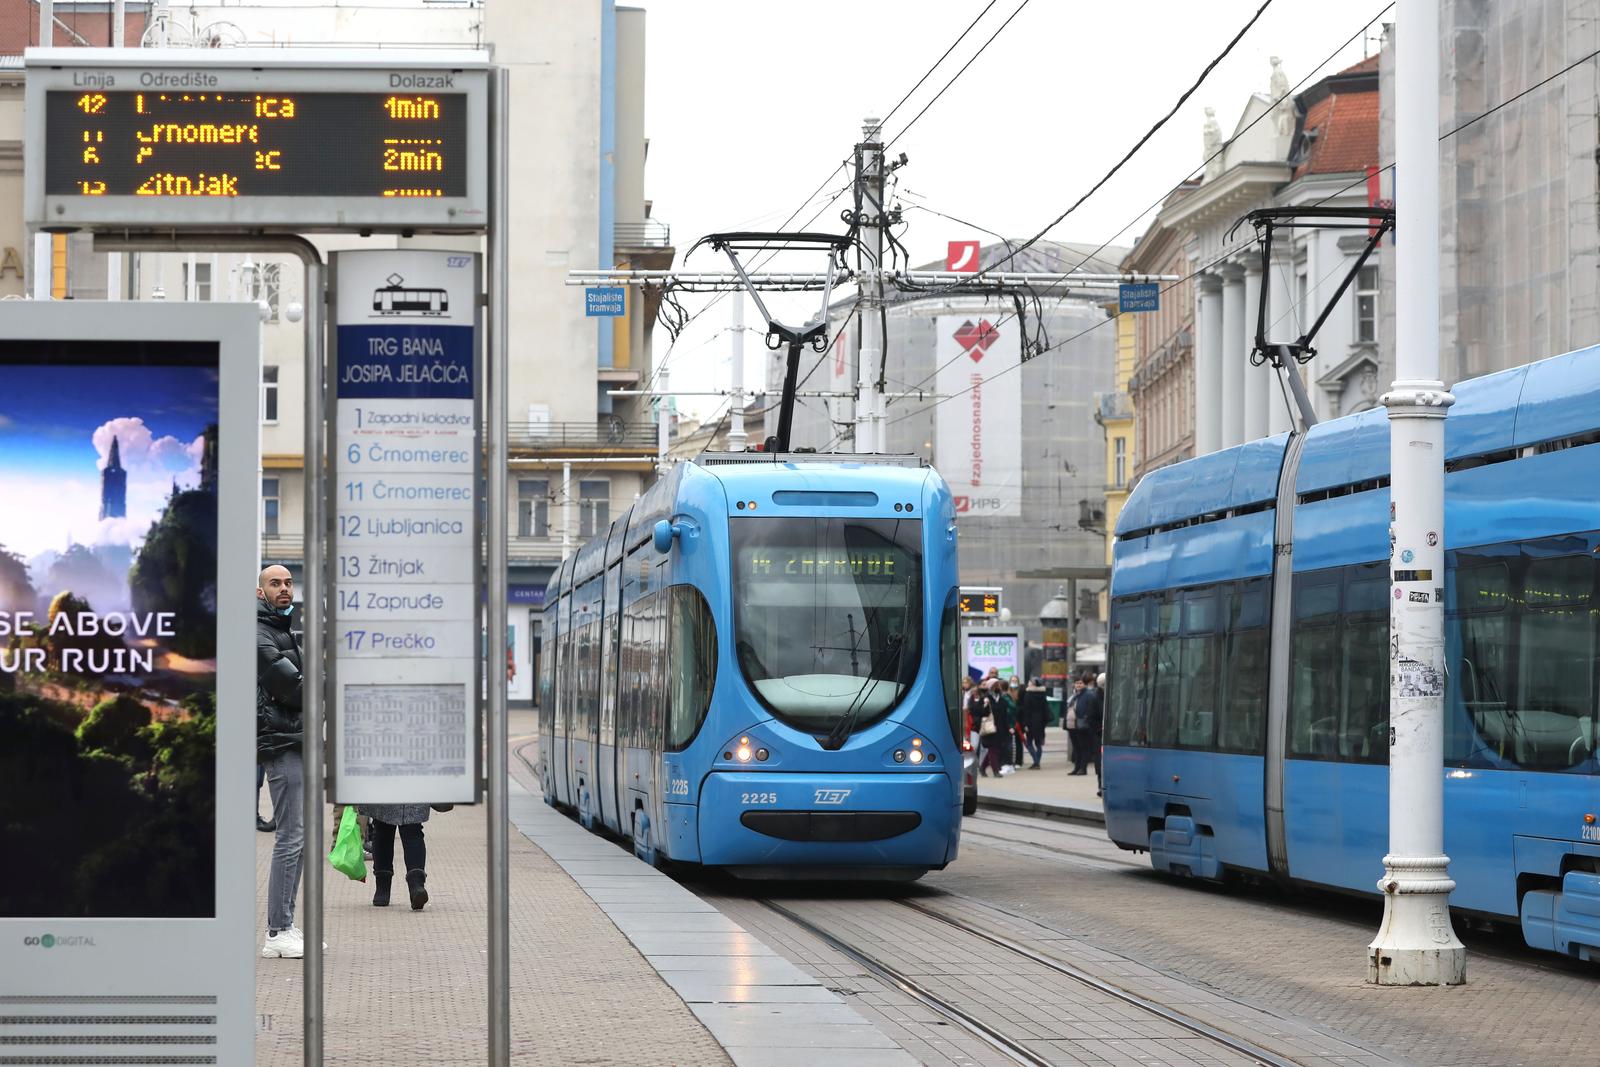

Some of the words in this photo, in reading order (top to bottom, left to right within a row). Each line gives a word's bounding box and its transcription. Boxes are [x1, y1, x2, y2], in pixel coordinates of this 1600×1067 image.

[73, 72, 115, 87] Linija
[140, 71, 218, 87] Odredište
[390, 73, 454, 88] Dolazak
[384, 96, 440, 118] 1min
[384, 149, 442, 171] 2min
[368, 338, 398, 356] TRG
[402, 338, 444, 356] BANA
[342, 364, 393, 383] JOSIPA
[397, 360, 468, 383] JELAČIĆA
[355, 408, 362, 429] 1
[367, 411, 420, 426] Zapadni
[347, 444, 361, 464] 6
[368, 443, 469, 463] Črnomerec
[345, 482, 363, 501] 11
[373, 480, 472, 500] Črnomerec
[970, 498, 1001, 510] HPB
[338, 515, 361, 537] 12
[367, 518, 463, 536] Ljubljanica
[339, 556, 361, 578] 13
[368, 555, 425, 577] Žitnjak
[339, 590, 360, 612] 14
[49, 611, 176, 636] ABOVE
[344, 630, 366, 650] 17
[371, 630, 436, 649] Prečko
[61, 648, 153, 673] RUIN
[671, 779, 689, 795] 2225
[814, 789, 852, 805] ZET
[741, 792, 778, 804] 2225
